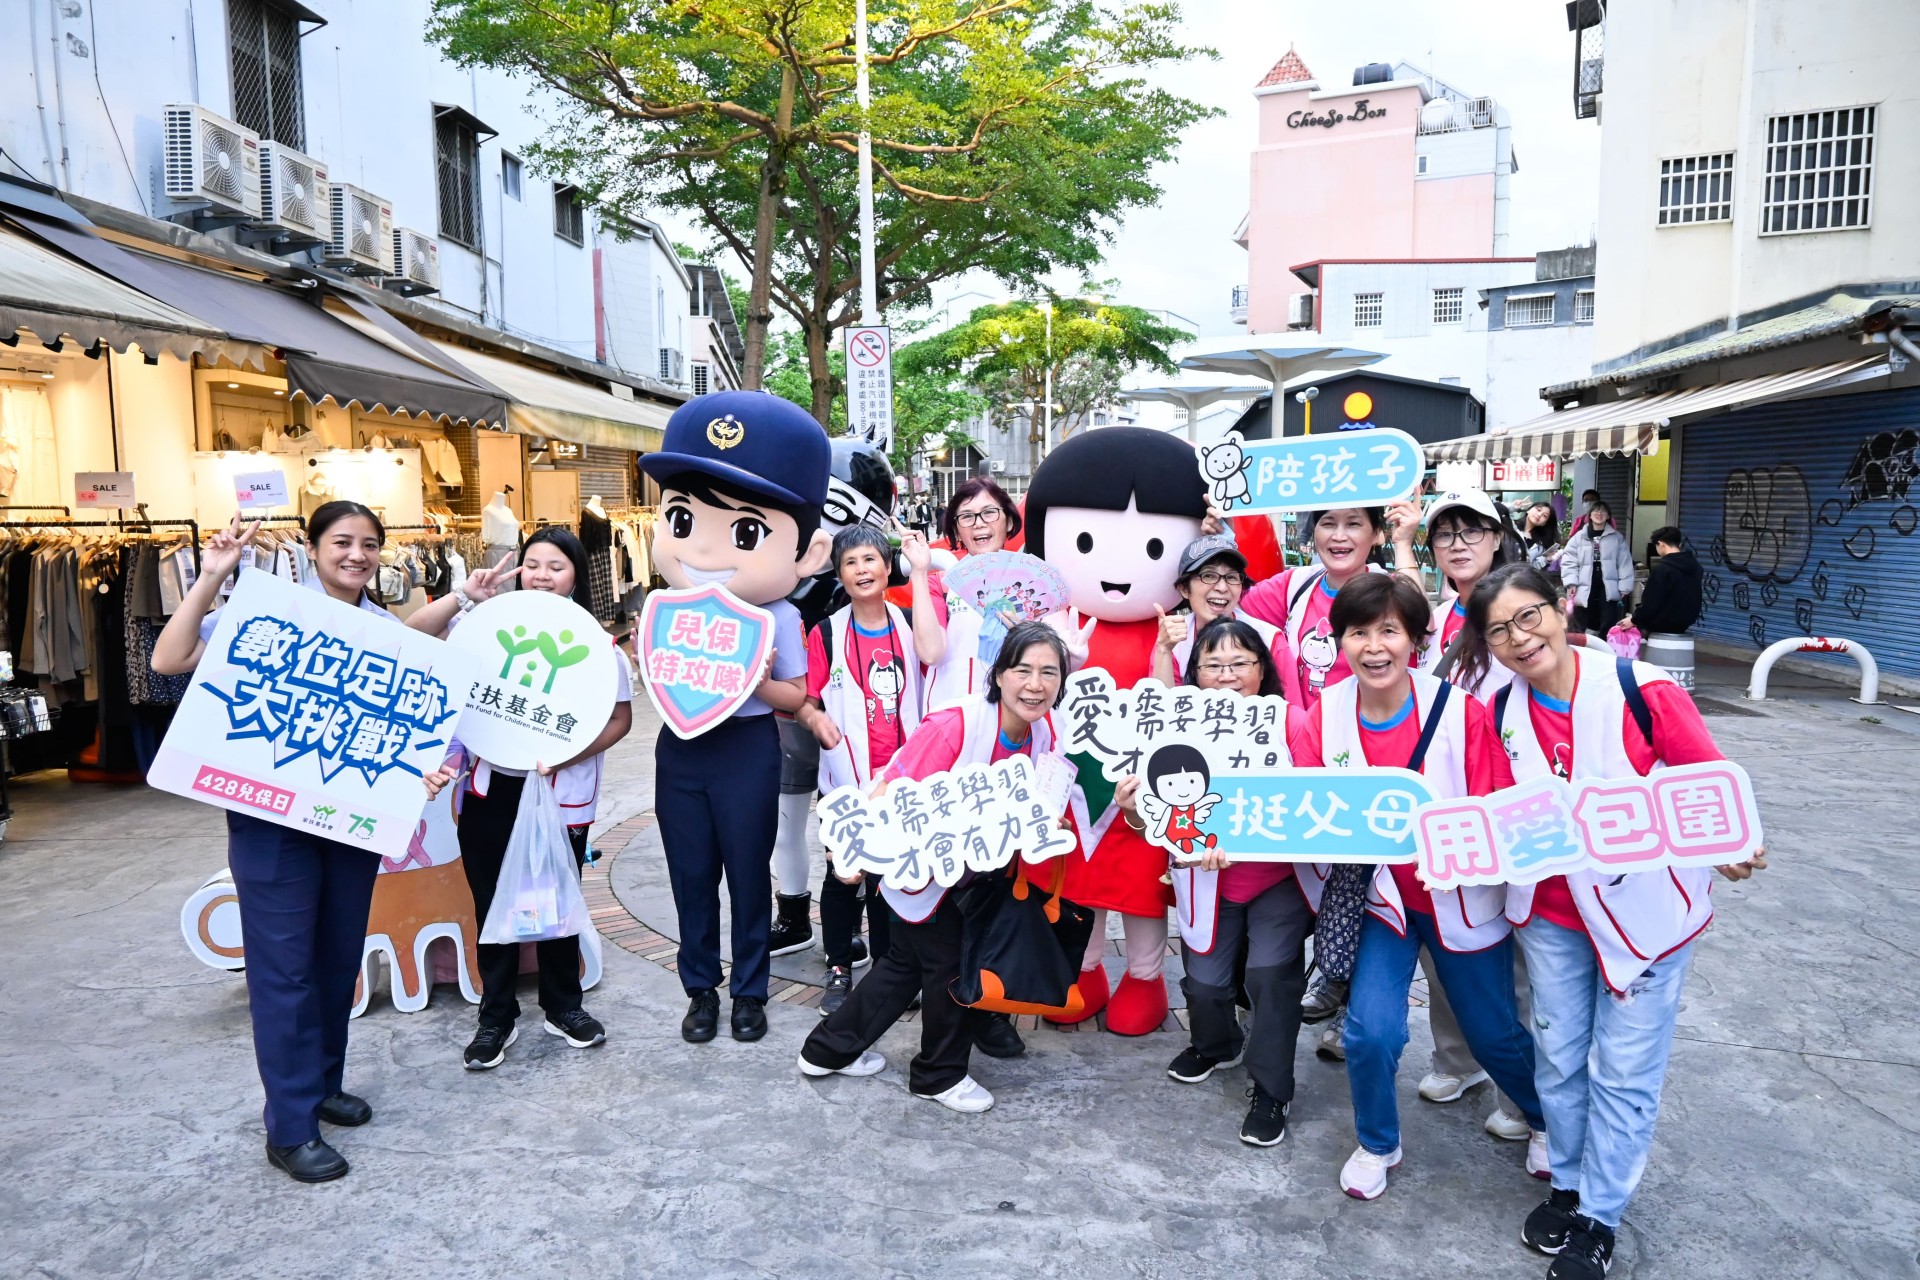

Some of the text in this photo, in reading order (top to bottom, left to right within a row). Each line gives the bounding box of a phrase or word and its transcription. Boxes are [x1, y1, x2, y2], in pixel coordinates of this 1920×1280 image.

[1346, 99, 1387, 121] Bon
[92, 484, 118, 492] SALE
[250, 483, 272, 492] SALE
[1257, 444, 1406, 497] 陪孩子
[671, 613, 737, 652] 兒保
[231, 617, 449, 729] 數位足跡
[652, 651, 742, 694] 特攻隊
[230, 675, 411, 773] 大挑戰
[475, 705, 492, 716] Fund
[493, 710, 503, 719] for
[504, 715, 531, 729] Children
[531, 725, 545, 734] and
[545, 729, 572, 743] Families
[198, 773, 290, 812] 428兒保日
[347, 813, 378, 838] 75
[1226, 787, 1419, 844] 挺父母
[1421, 771, 1749, 880] 用愛包圍
[894, 803, 1068, 880] 才會有力量
